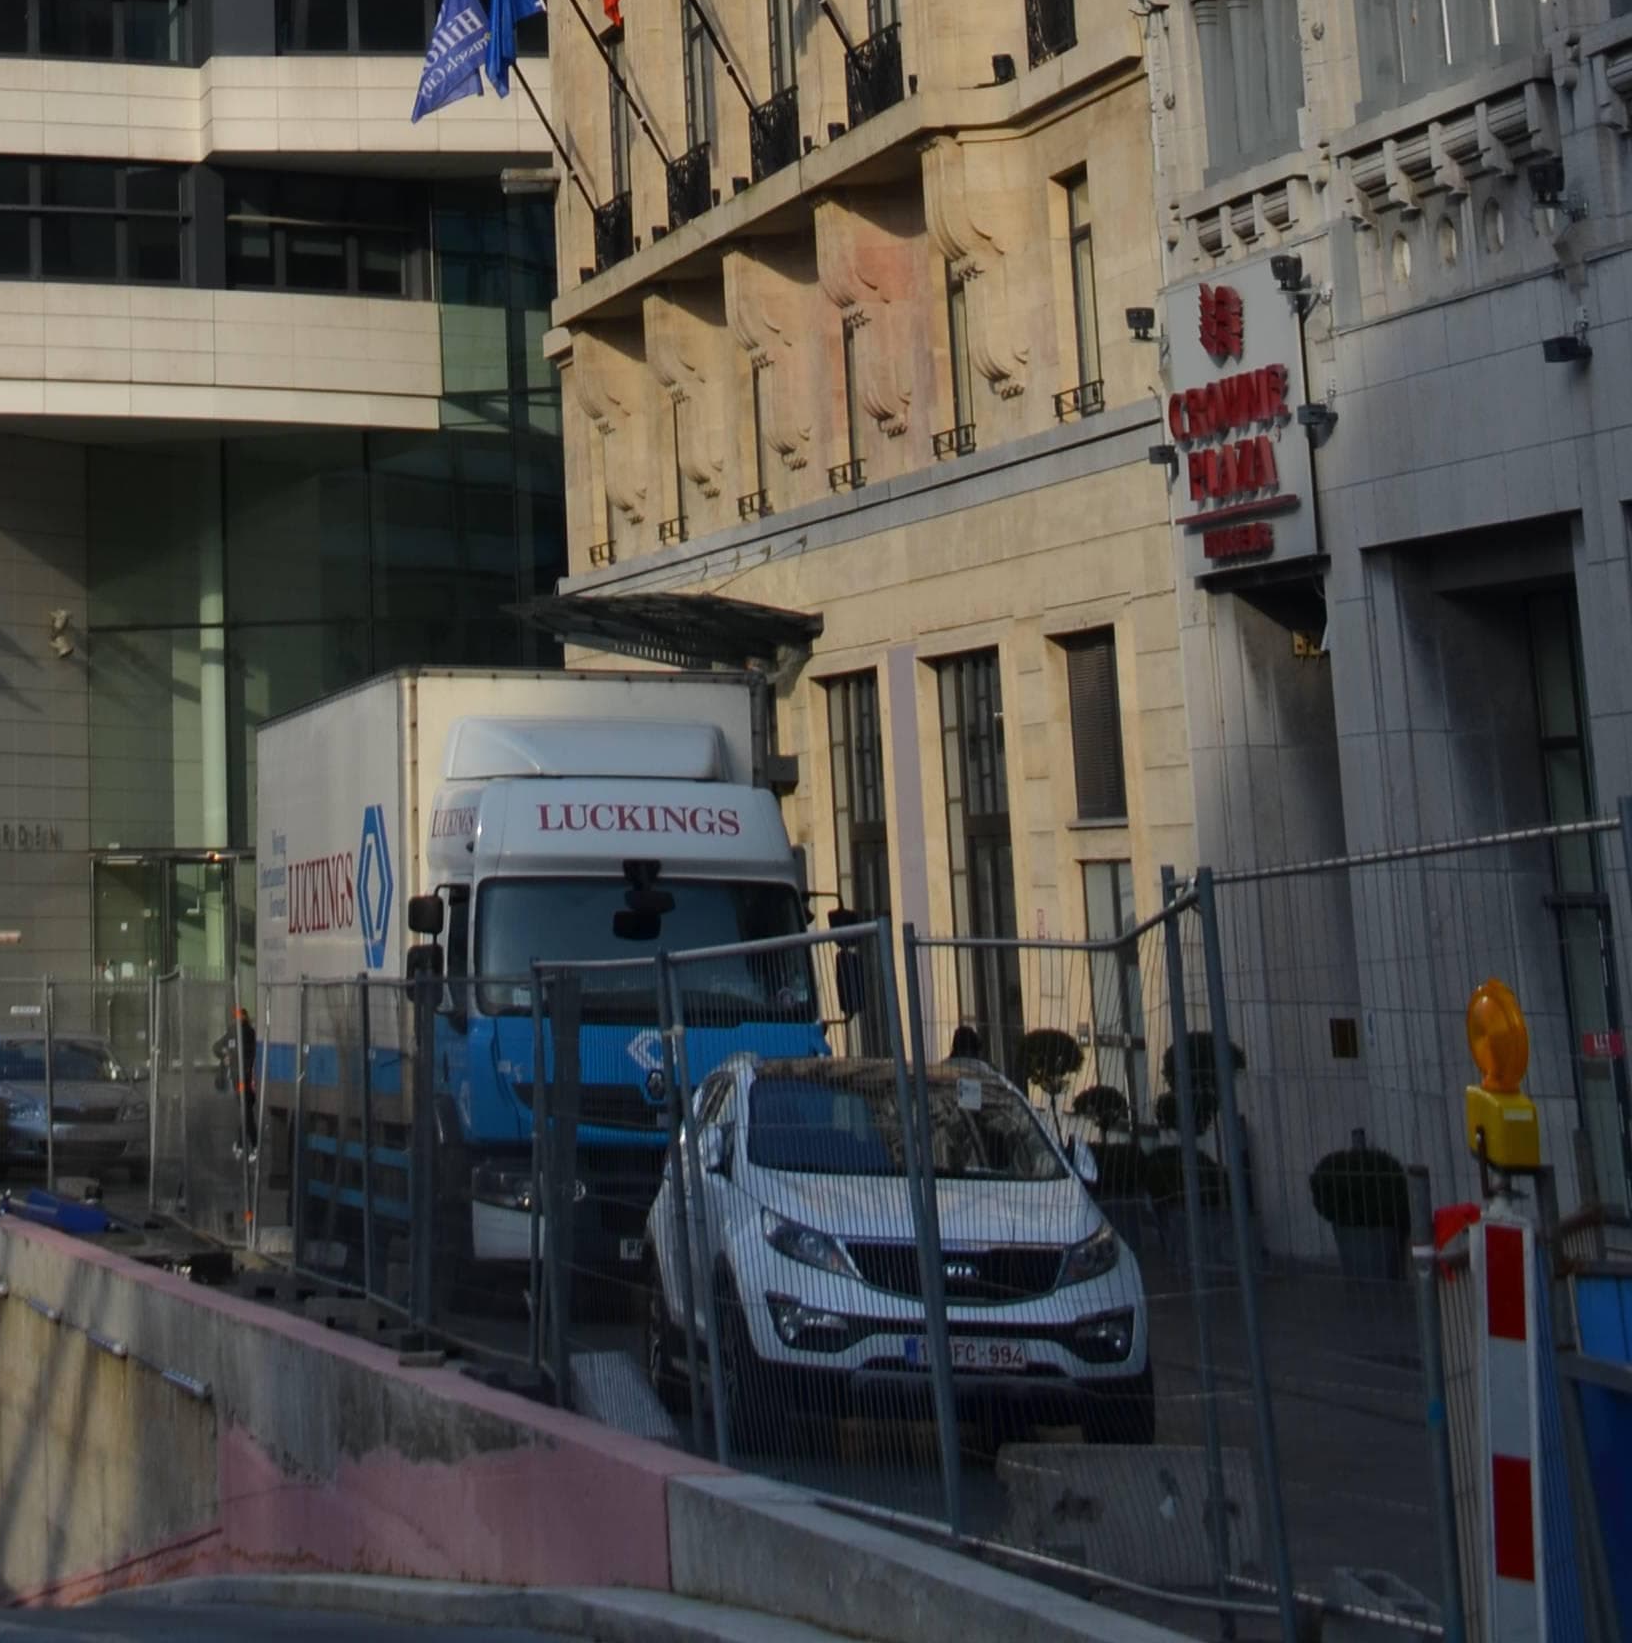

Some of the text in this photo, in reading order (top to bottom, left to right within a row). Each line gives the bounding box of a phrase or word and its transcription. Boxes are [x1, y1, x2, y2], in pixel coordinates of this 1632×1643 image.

[1169, 363, 1288, 444] CROWNE
[1188, 435, 1279, 502] PLAZA
[536, 803, 741, 837] LUCKINGS
[288, 850, 354, 934] LUCKINGS
[920, 1341, 1025, 1365] 1FC-994
